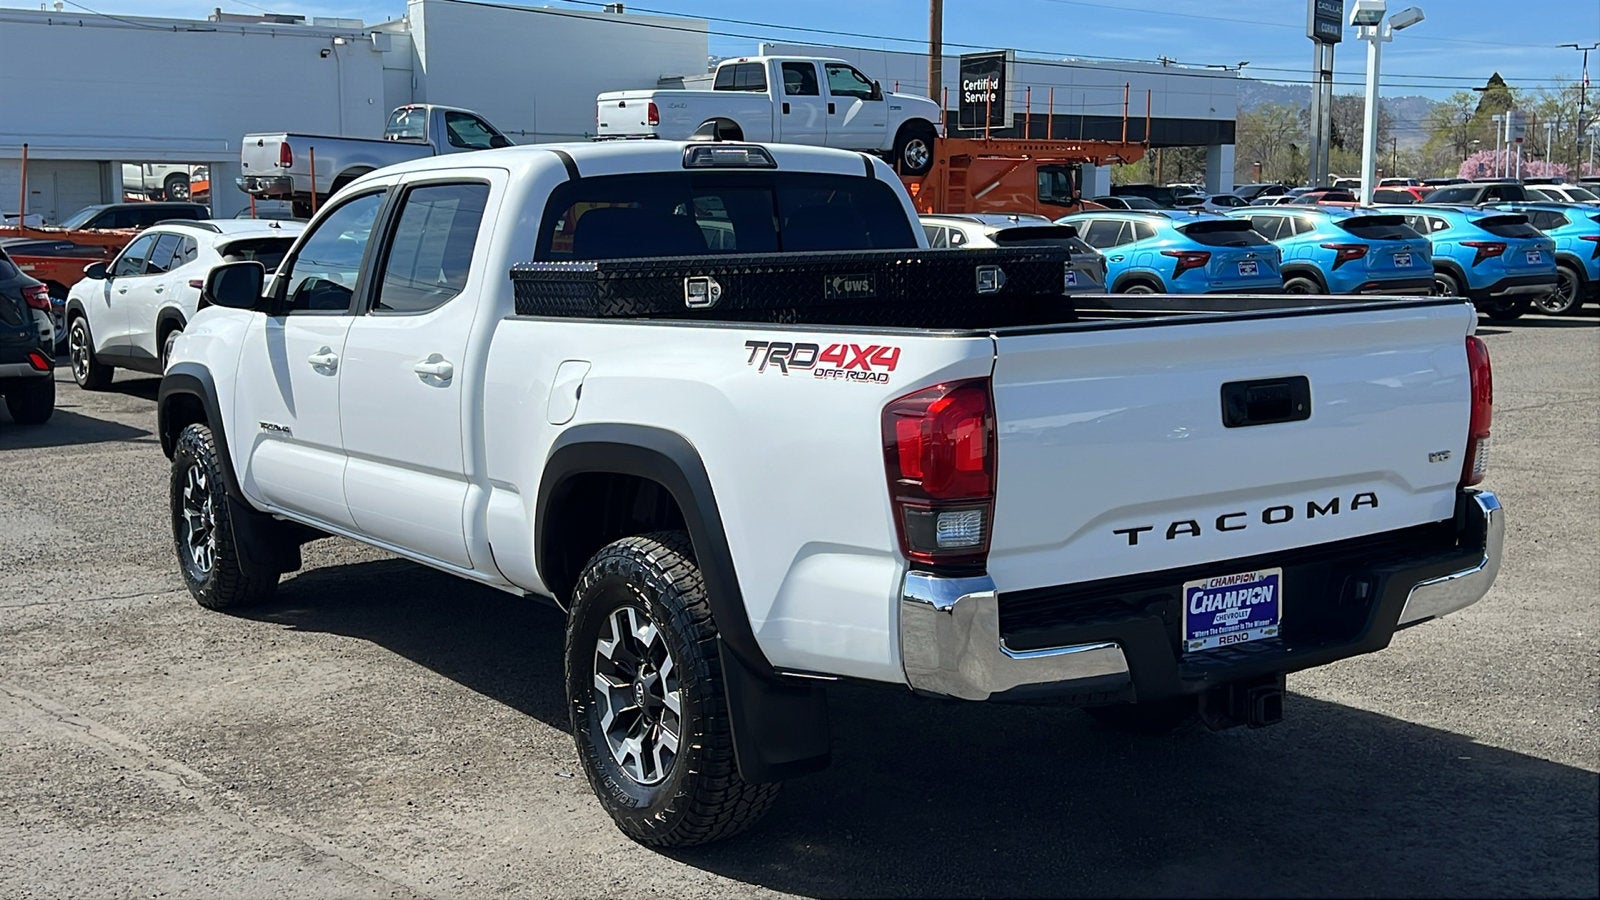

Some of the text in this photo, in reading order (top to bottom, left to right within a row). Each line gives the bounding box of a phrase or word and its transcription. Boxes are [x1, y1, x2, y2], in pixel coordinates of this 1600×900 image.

[844, 279, 869, 291] UWS
[745, 340, 820, 376] TRD
[813, 368, 890, 384] OFF ROAD
[1112, 491, 1379, 545] TACOMA
[1211, 573, 1256, 587] CHAMPION
[1190, 585, 1274, 615] CHAMPION
[1215, 611, 1249, 622] CHEVROLET
[1219, 632, 1249, 645] RENO
